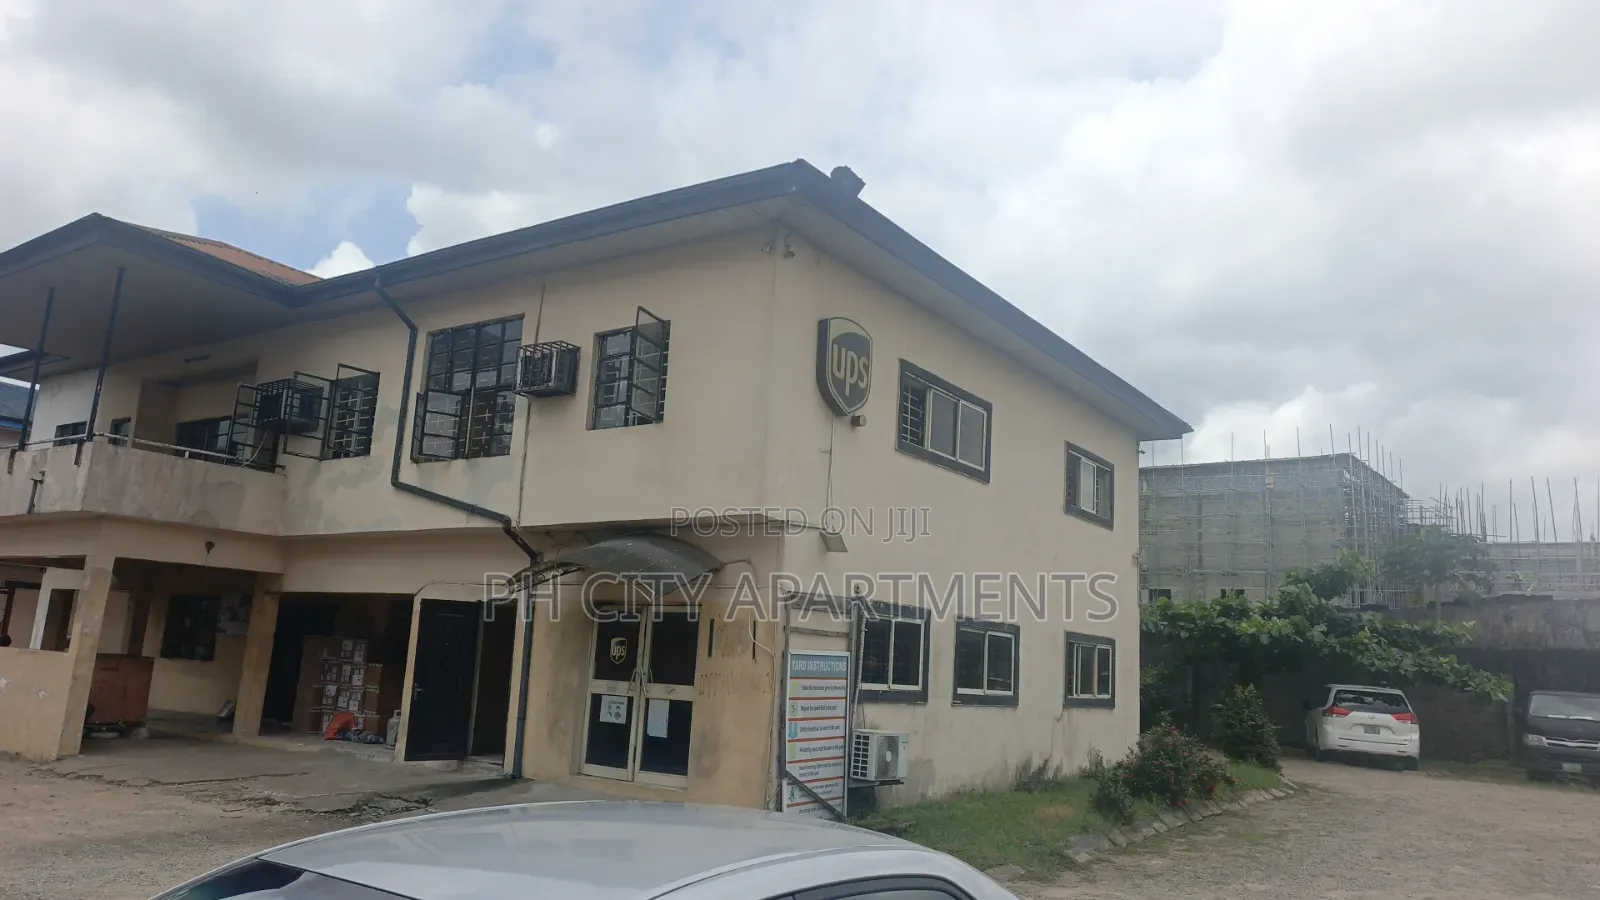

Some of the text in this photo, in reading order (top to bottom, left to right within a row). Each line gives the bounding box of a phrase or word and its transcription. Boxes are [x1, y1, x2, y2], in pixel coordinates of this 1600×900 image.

[832, 343, 869, 396] ups
[611, 645, 625, 660] ups
[792, 659, 847, 672] YARD INSTRUCTIONS
